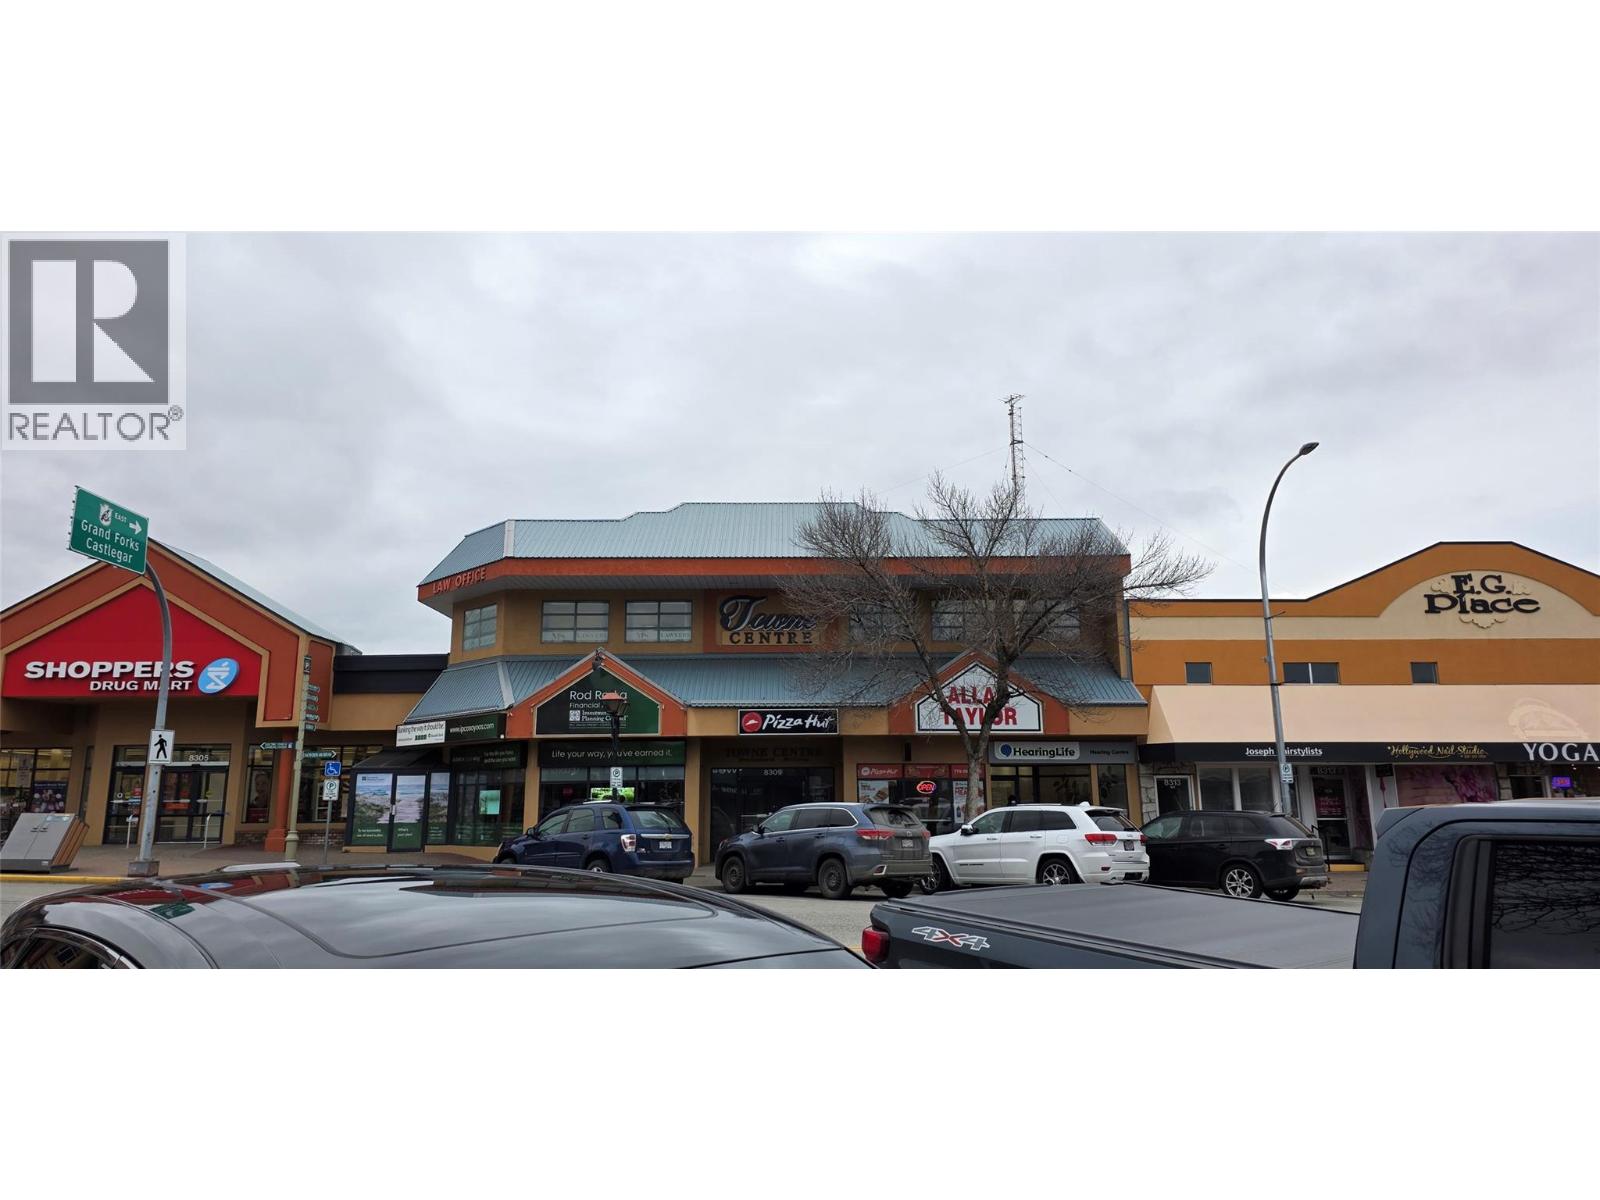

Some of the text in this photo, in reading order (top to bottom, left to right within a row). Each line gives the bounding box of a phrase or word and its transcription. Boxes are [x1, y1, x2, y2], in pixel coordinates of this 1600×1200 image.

[81, 519, 140, 552] Grand Forks
[86, 537, 133, 563] Castlegar
[432, 567, 487, 594] LAW OFFICE
[1451, 573, 1512, 594] E.G.
[1424, 593, 1541, 614] Place
[729, 631, 812, 645] CENTRE
[24, 660, 195, 679] SHOPPERS
[90, 680, 192, 691] DRUG MRT
[569, 690, 592, 700] Rod
[948, 686, 996, 704] ALLA
[762, 713, 834, 730] Pizza Hut
[551, 749, 565, 758] Life
[567, 750, 585, 759] your
[587, 750, 605, 759] way,
[607, 749, 632, 759] yu've
[635, 748, 663, 757] earned
[1013, 743, 1076, 758] HearingLife
[1245, 746, 1323, 757] Joseph airstylists
[1522, 743, 1599, 761] YOGA
[763, 768, 783, 776] 8309
[919, 783, 935, 792] OPEN
